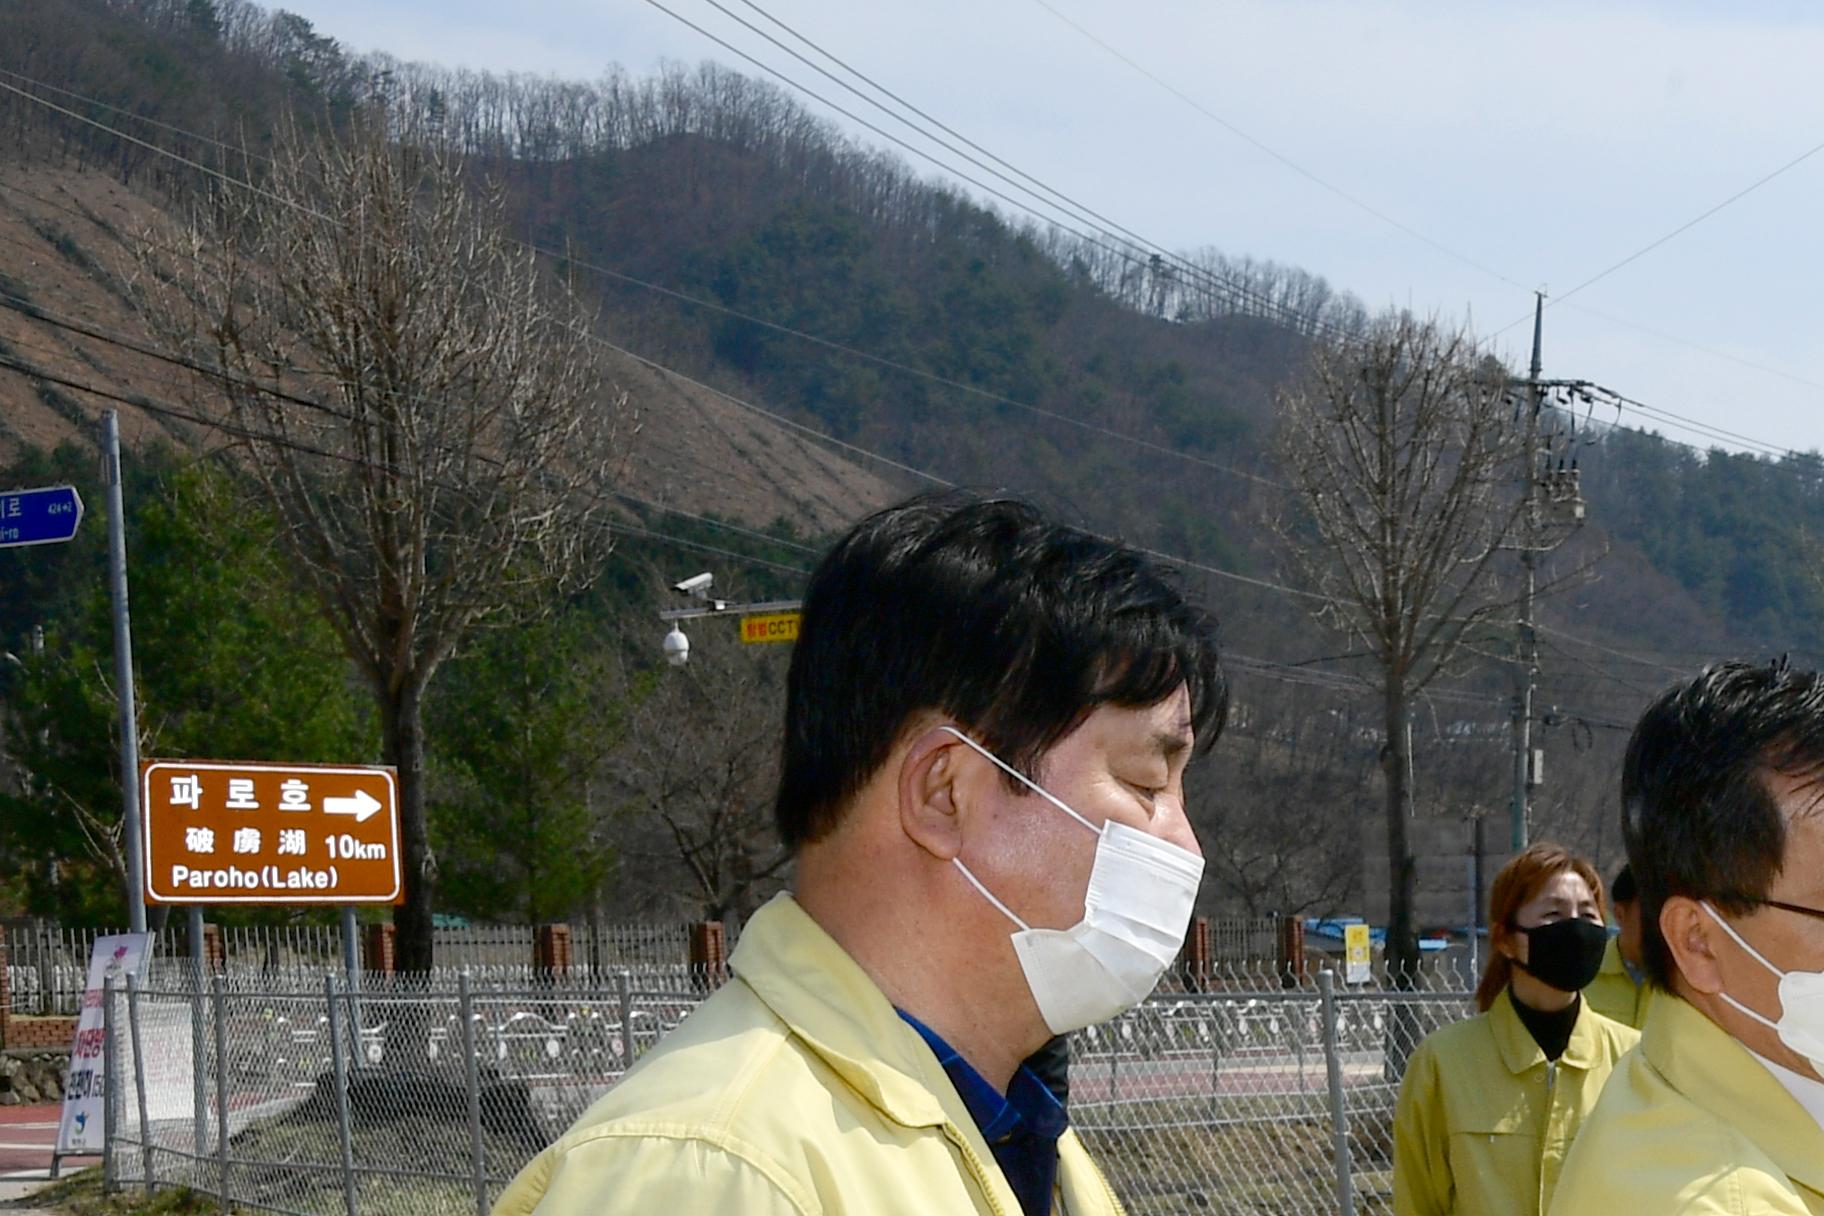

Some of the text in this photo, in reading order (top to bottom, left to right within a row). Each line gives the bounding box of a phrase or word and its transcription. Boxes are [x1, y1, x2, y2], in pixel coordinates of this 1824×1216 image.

[169, 774, 312, 812] 파로호
[324, 835, 387, 860] 10km
[172, 865, 338, 889] Paroho(Lake)
